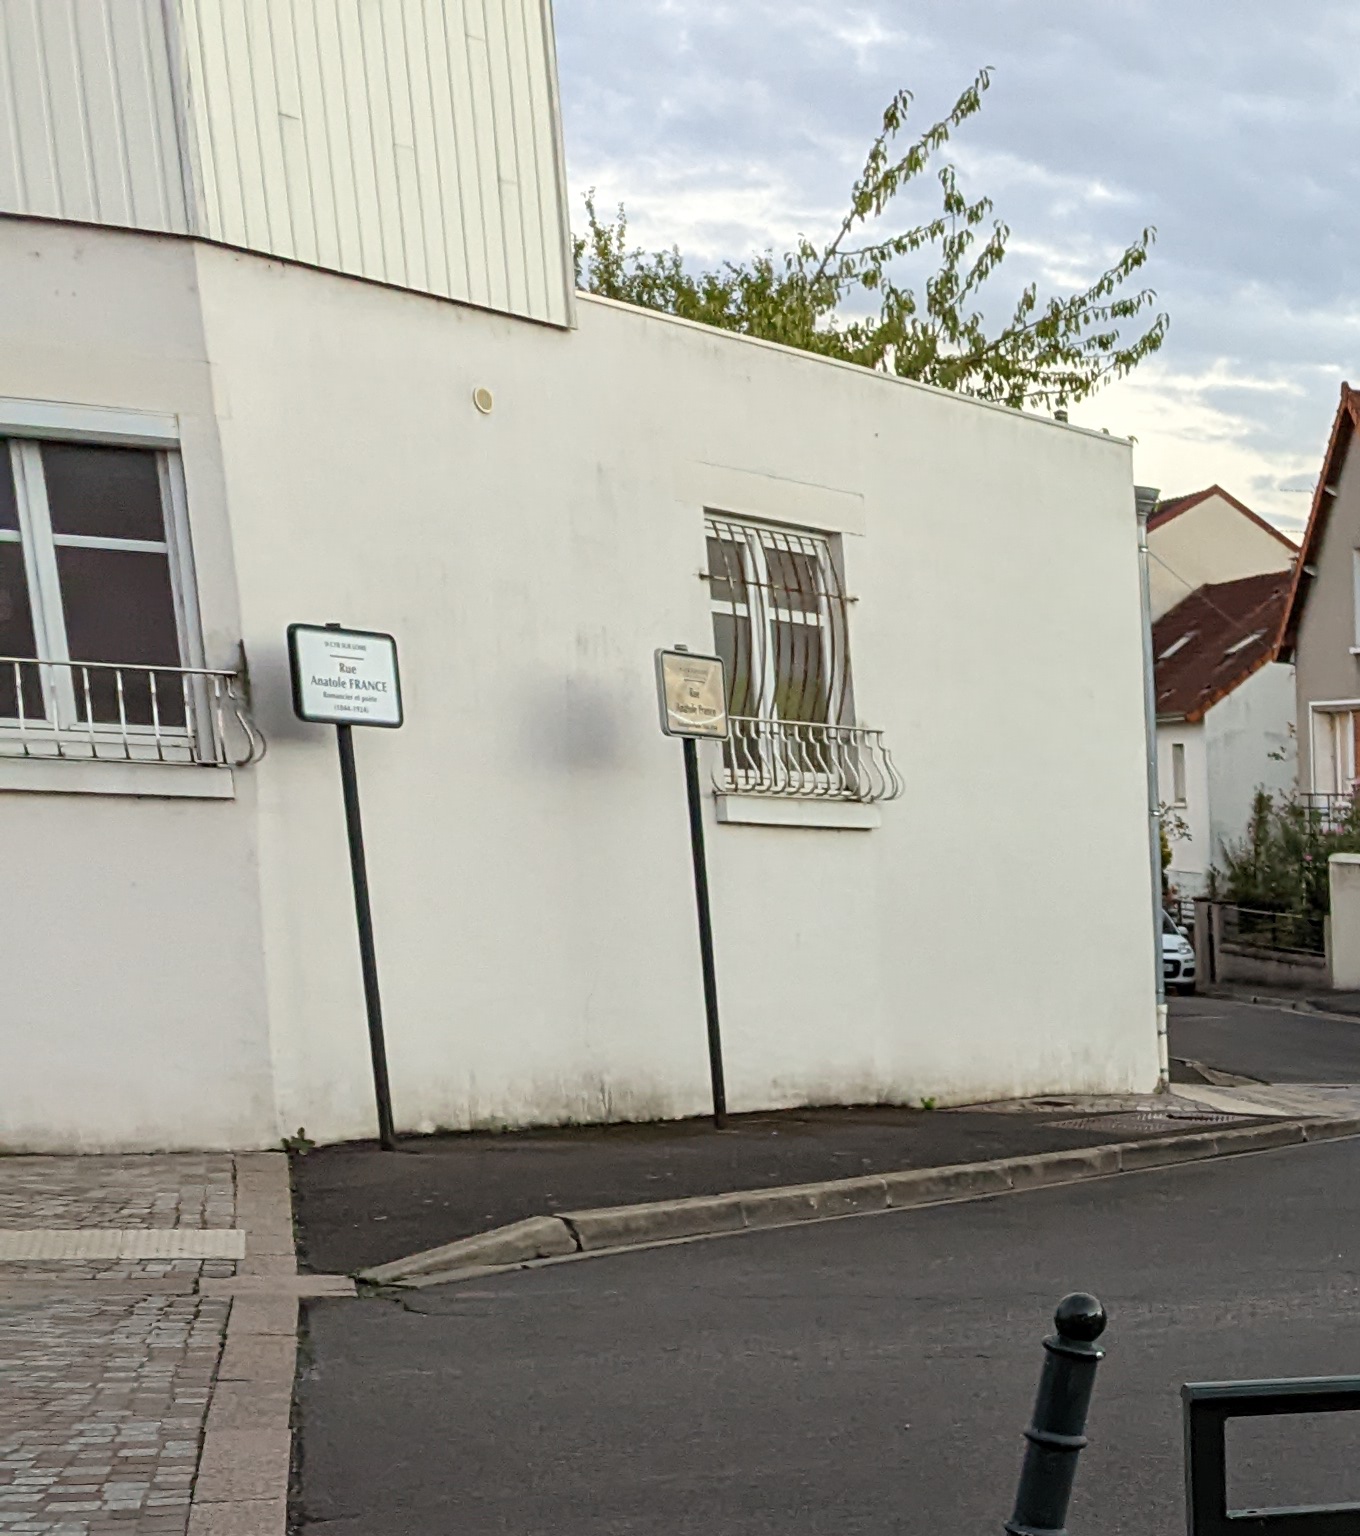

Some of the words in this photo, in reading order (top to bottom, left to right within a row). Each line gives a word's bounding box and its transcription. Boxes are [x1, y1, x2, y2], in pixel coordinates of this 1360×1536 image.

[339, 662, 357, 675] Rue
[310, 675, 346, 689] Anatole
[349, 678, 388, 693] FRANCE
